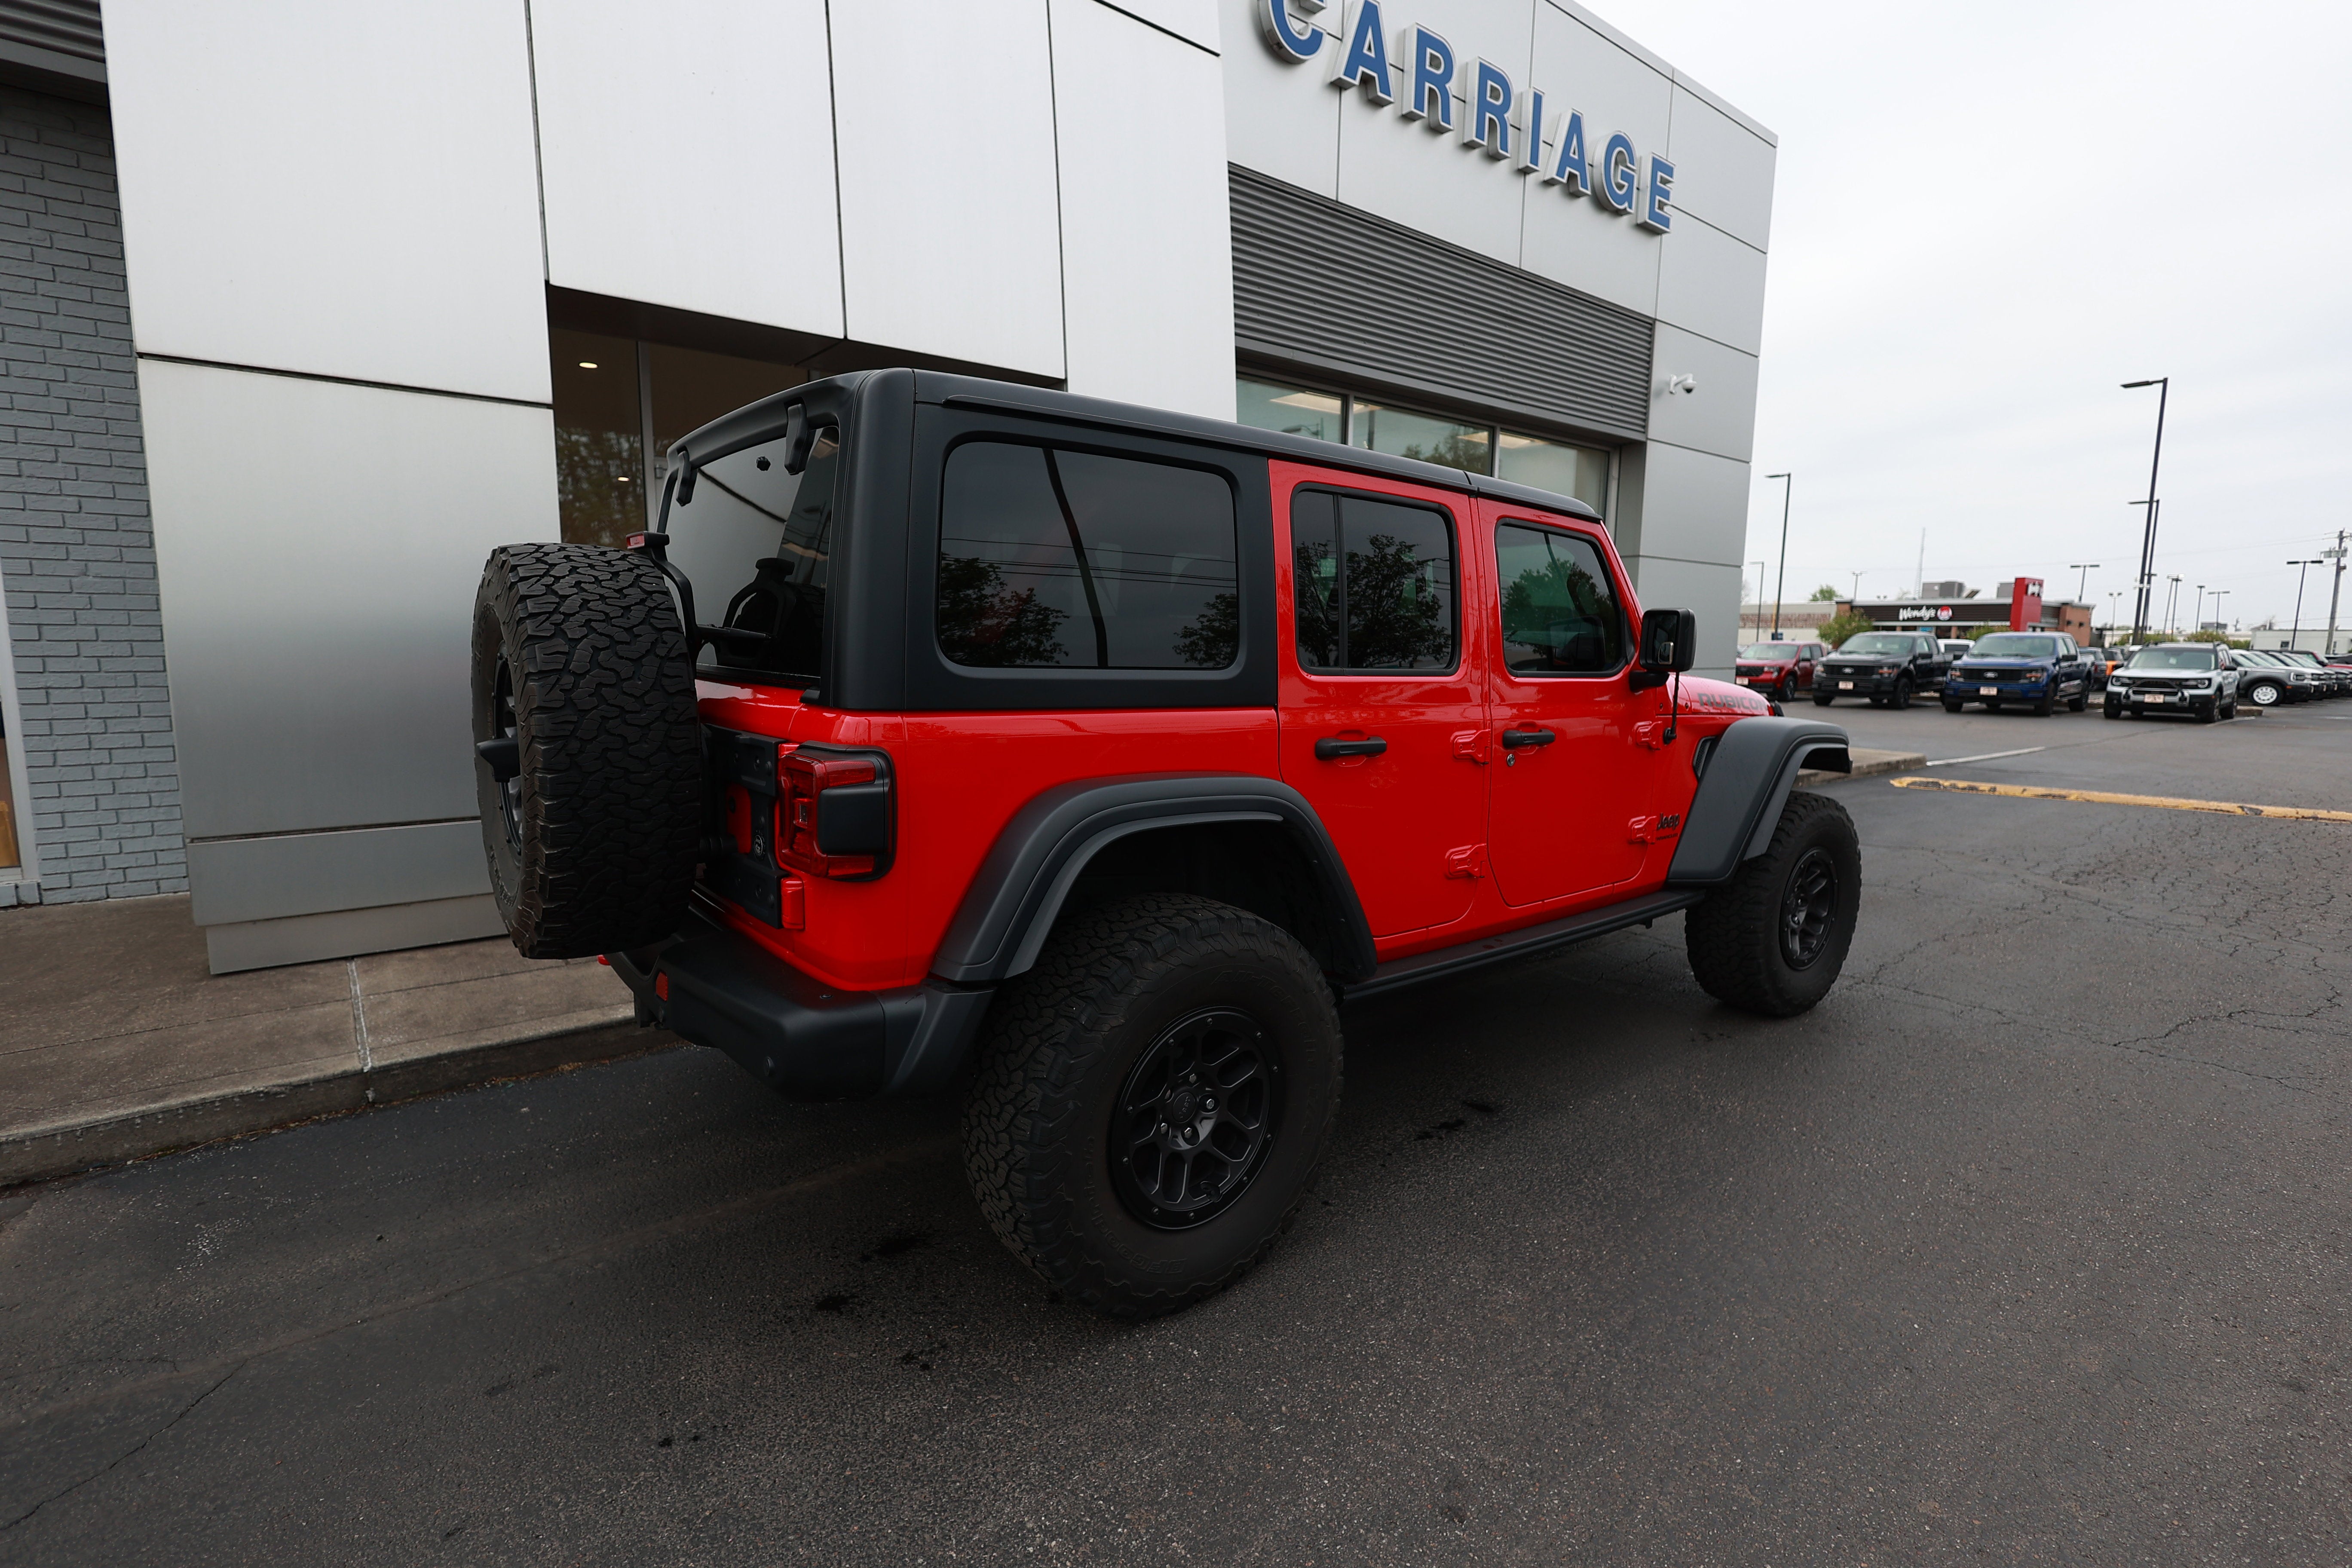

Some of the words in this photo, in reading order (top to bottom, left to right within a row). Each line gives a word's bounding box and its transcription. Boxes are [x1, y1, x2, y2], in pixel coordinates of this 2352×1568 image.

[1899, 605, 1936, 621] Wendy's
[1697, 693, 1768, 711] RUBICON
[1656, 812, 1680, 830] Jeep
